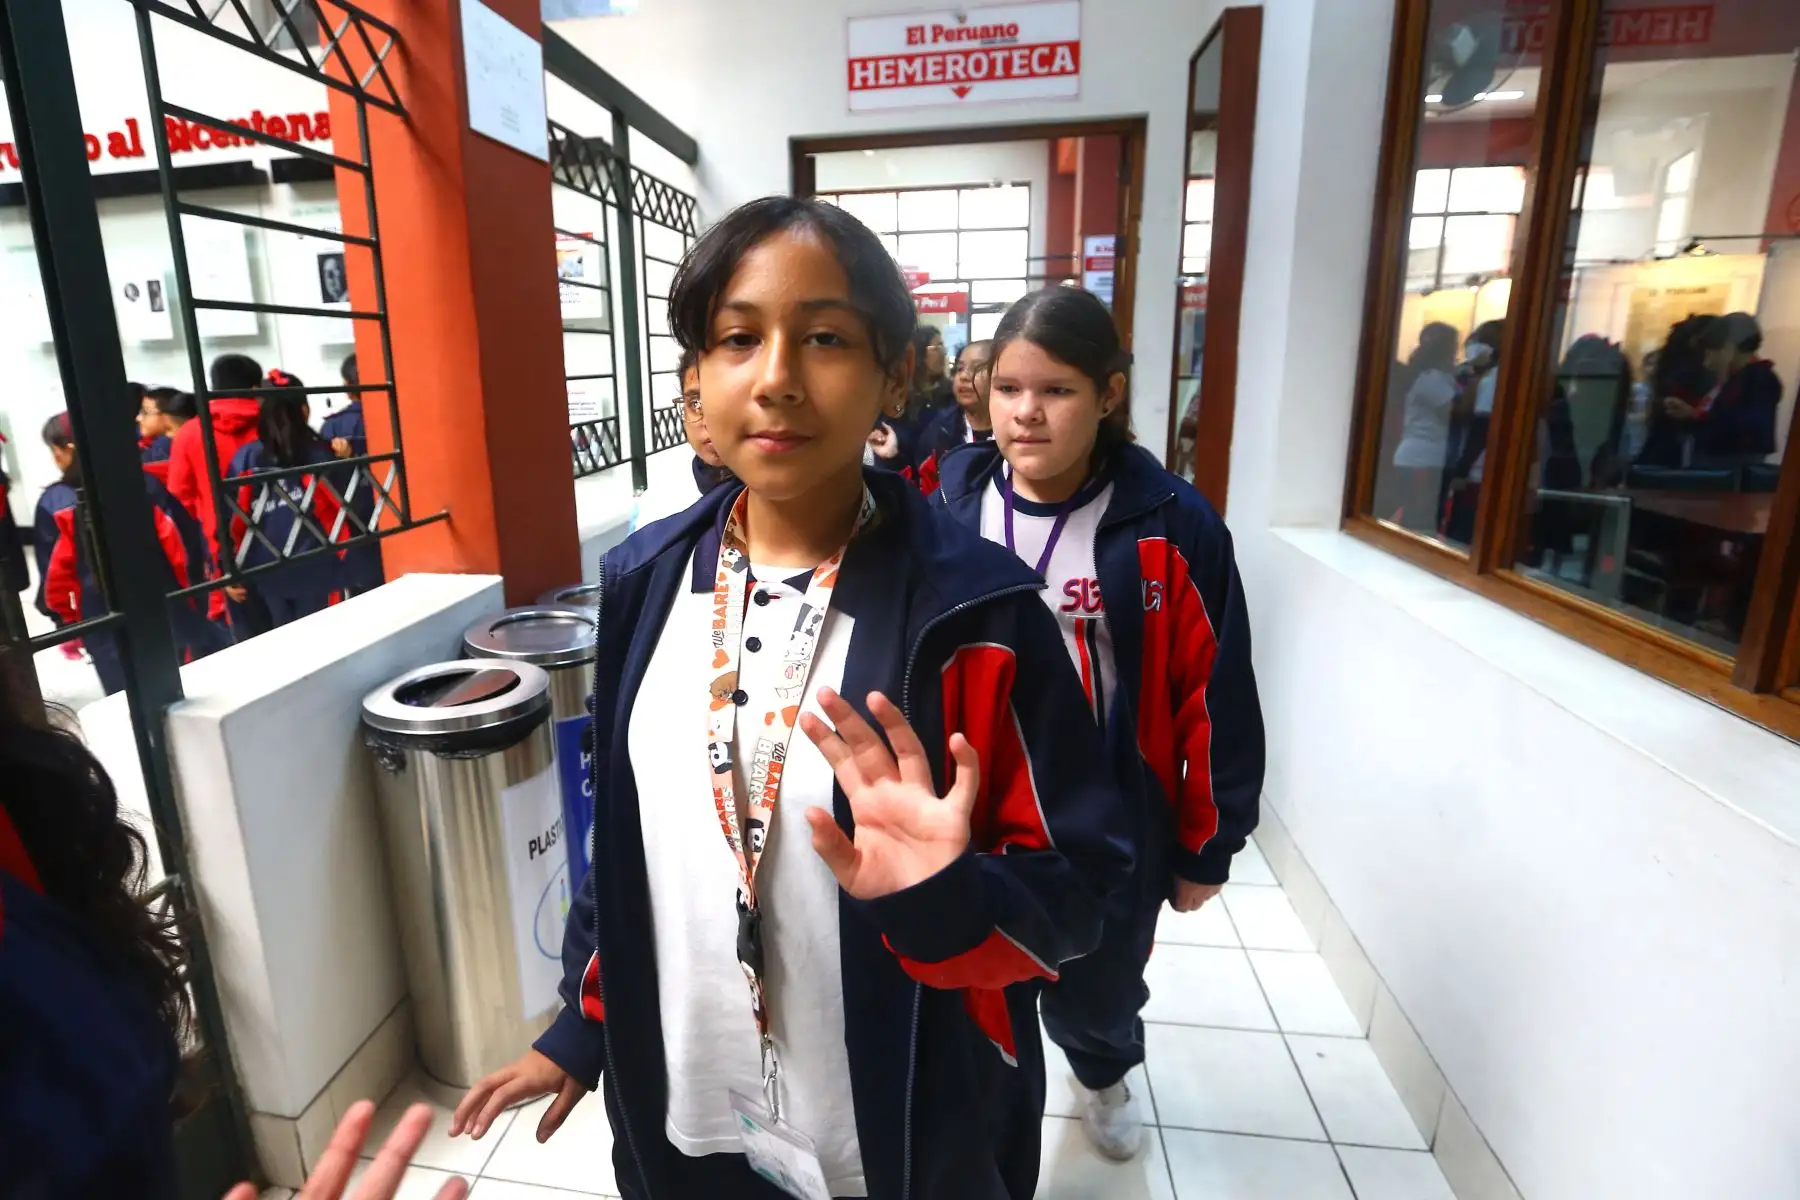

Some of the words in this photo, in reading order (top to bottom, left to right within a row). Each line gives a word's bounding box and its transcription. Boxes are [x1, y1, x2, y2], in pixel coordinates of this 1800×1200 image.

[906, 26, 925, 45] El
[931, 22, 1019, 43] Peruano
[851, 46, 1075, 88] HEMEROTECA
[107, 118, 145, 158] al
[712, 583, 729, 629] BARE
[711, 630, 725, 649] We
[748, 737, 774, 806] BEARS
[761, 760, 784, 811] BARE
